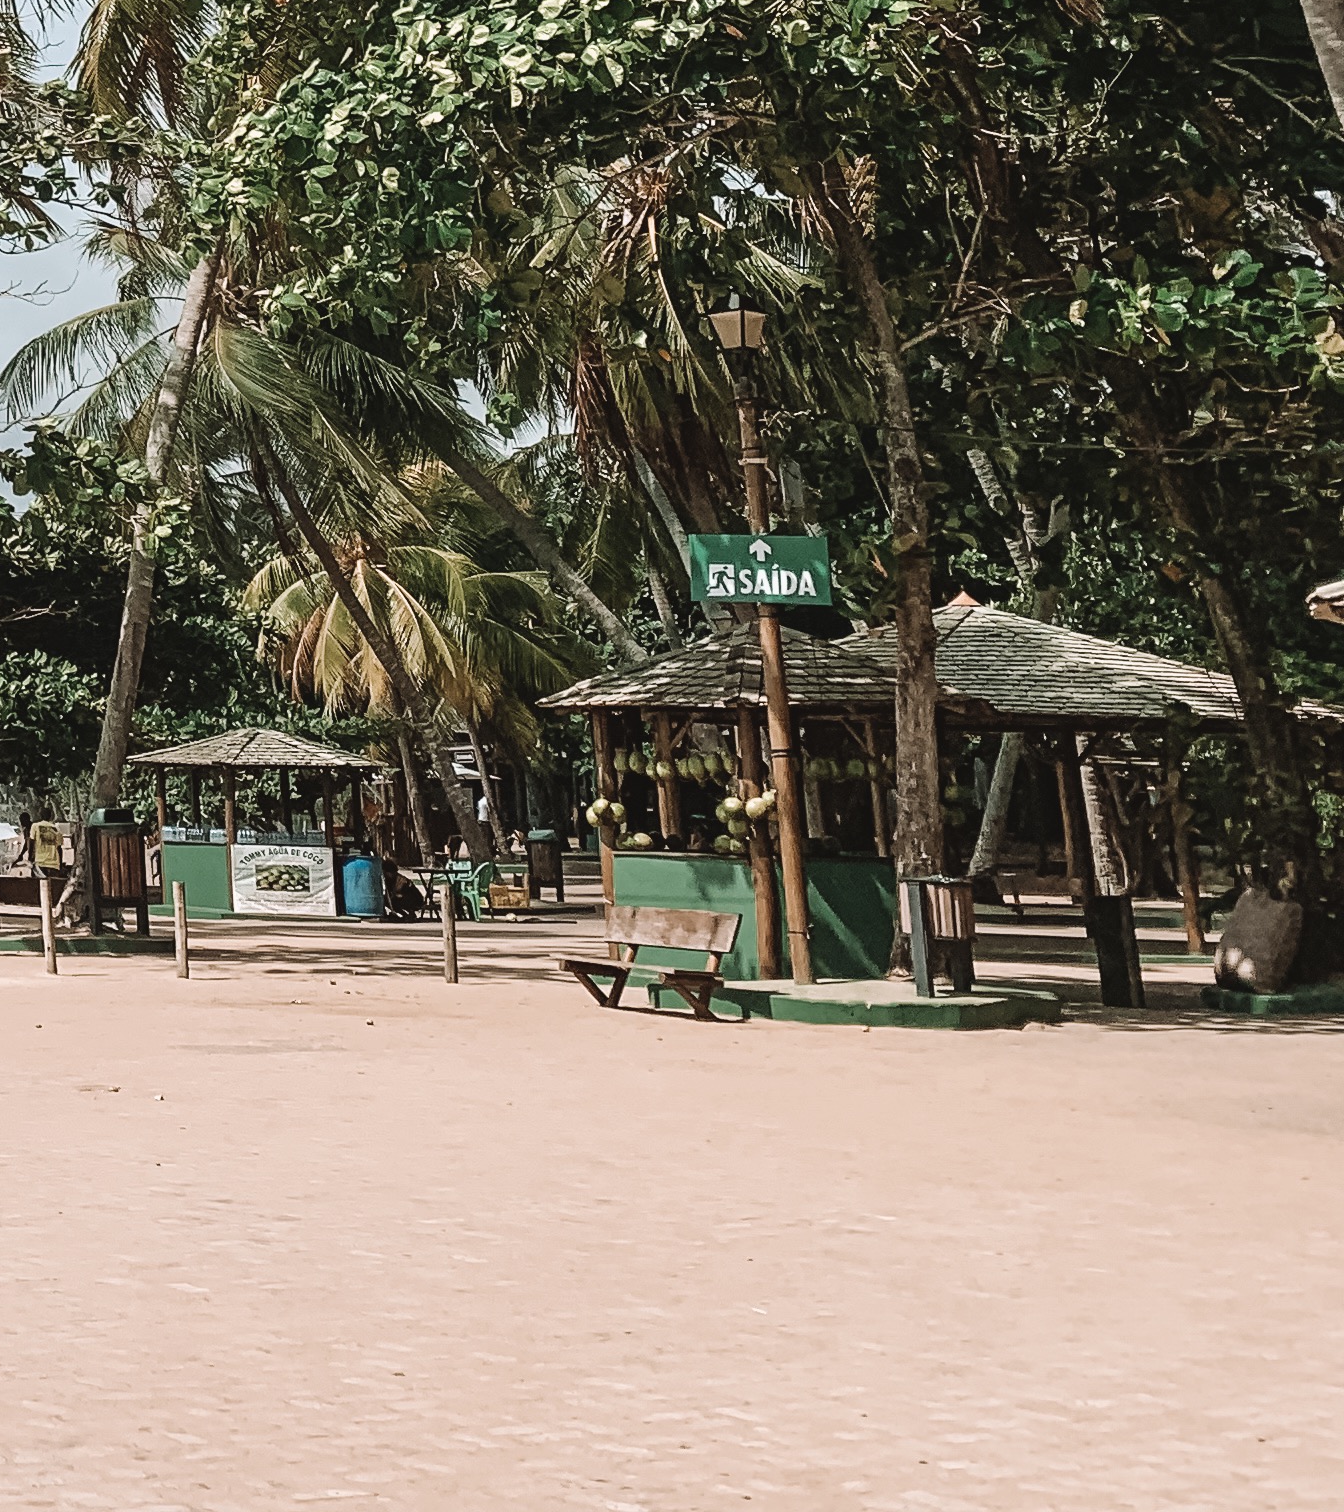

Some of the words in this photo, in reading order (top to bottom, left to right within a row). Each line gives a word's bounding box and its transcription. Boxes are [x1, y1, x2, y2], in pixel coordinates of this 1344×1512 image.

[738, 563, 817, 597] SAÍDA
[239, 849, 266, 865] TOMMY
[291, 849, 301, 857] DE
[302, 850, 325, 865] COCO
